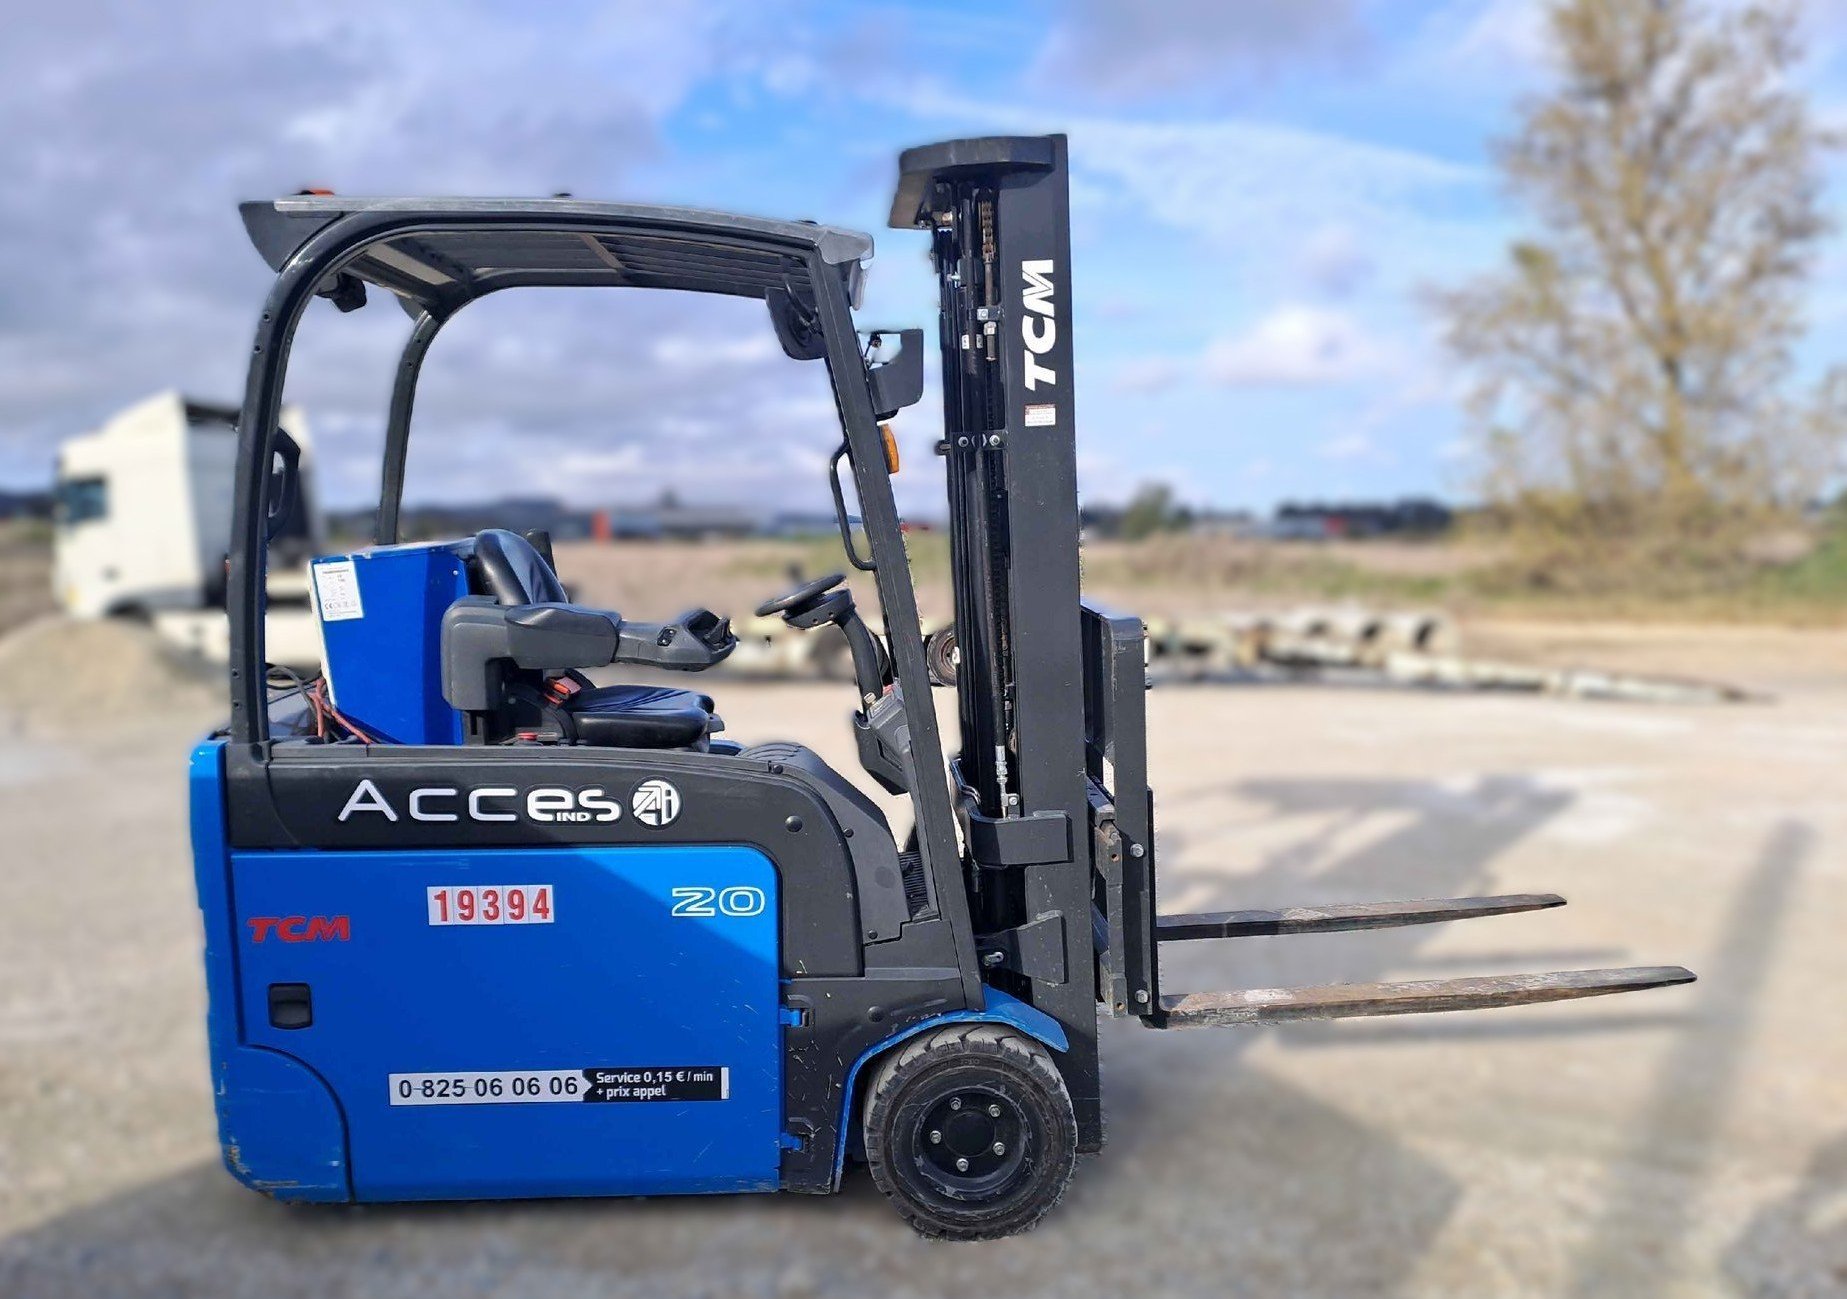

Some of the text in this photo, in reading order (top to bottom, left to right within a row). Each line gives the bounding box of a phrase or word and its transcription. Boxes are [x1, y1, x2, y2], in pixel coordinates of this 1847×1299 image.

[1021, 259, 1056, 391] TCM
[556, 812, 591, 821] IND
[433, 888, 550, 922] 19394
[671, 886, 765, 917] 20
[248, 916, 350, 942] TCM
[474, 1078, 503, 1097] 06
[512, 1077, 541, 1096] 06
[549, 1076, 578, 1095] 06
[596, 1072, 641, 1083] Service
[643, 1071, 673, 1084] 0,15
[606, 1086, 630, 1100] prix
[632, 1084, 667, 1100] appel
